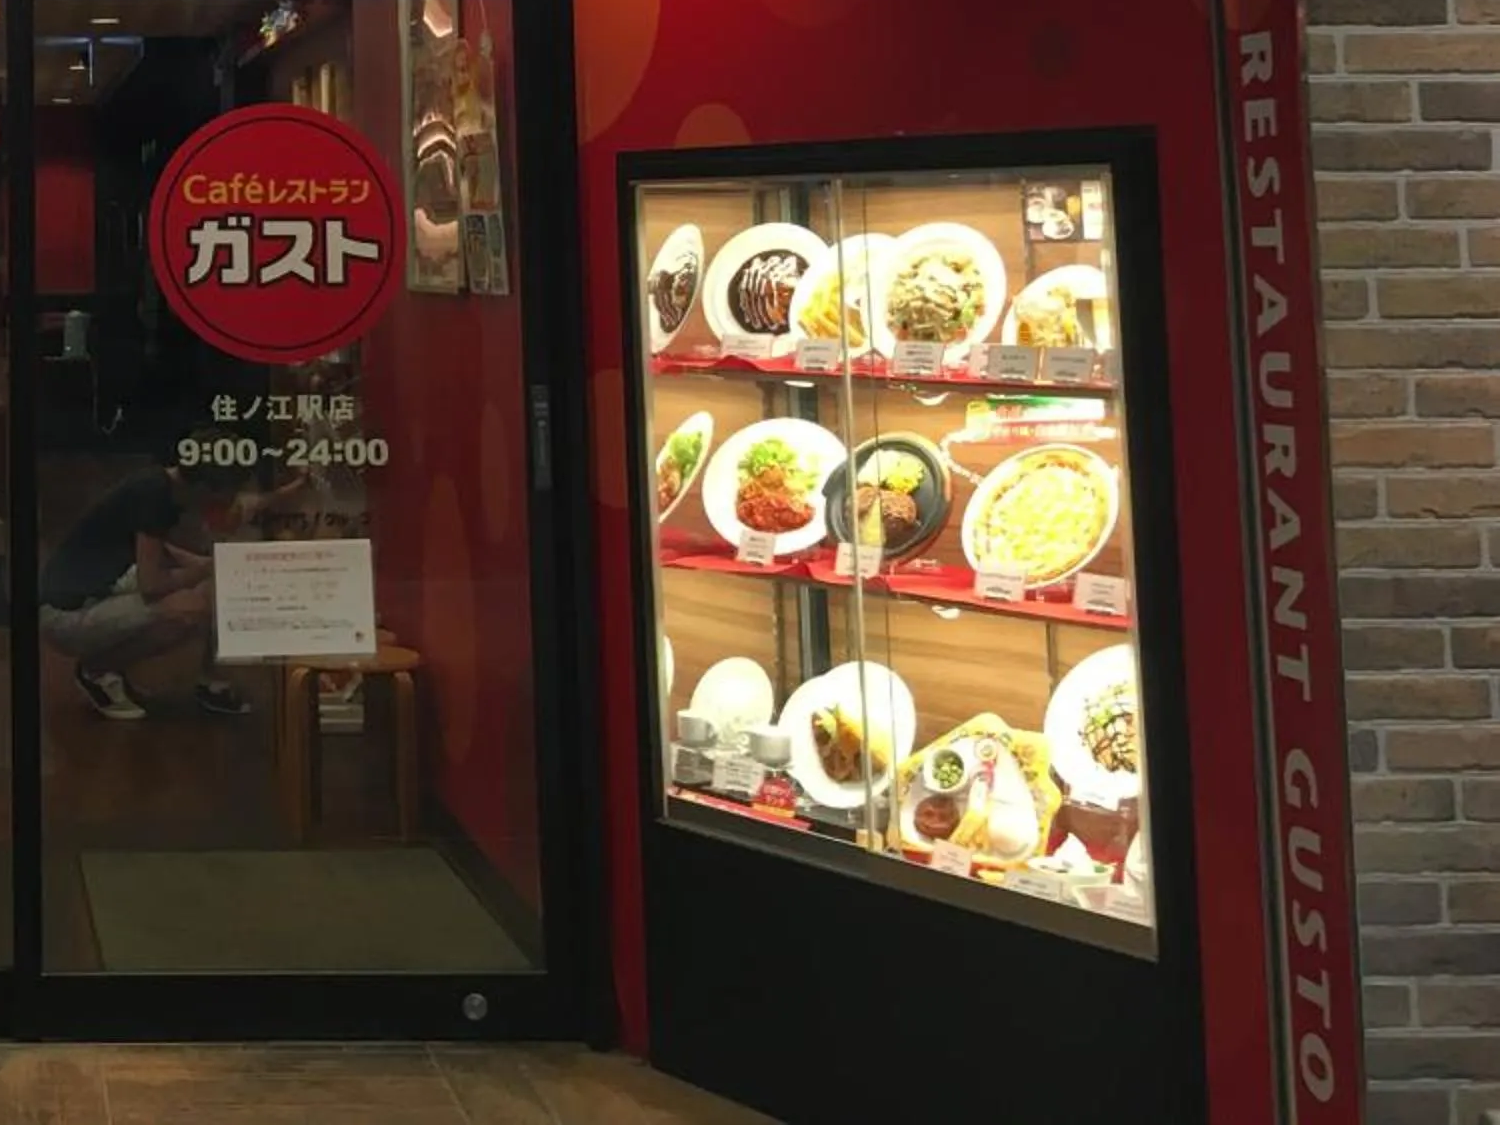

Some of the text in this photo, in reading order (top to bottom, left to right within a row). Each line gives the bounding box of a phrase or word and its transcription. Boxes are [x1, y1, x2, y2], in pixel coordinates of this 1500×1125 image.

[182, 174, 371, 206] Caféレストラン
[187, 215, 380, 286] ガスト
[210, 393, 356, 423] 住ノ江駅店
[1238, 30, 1310, 702] RESTAURANT
[1283, 747, 1335, 1104] GUSTO
